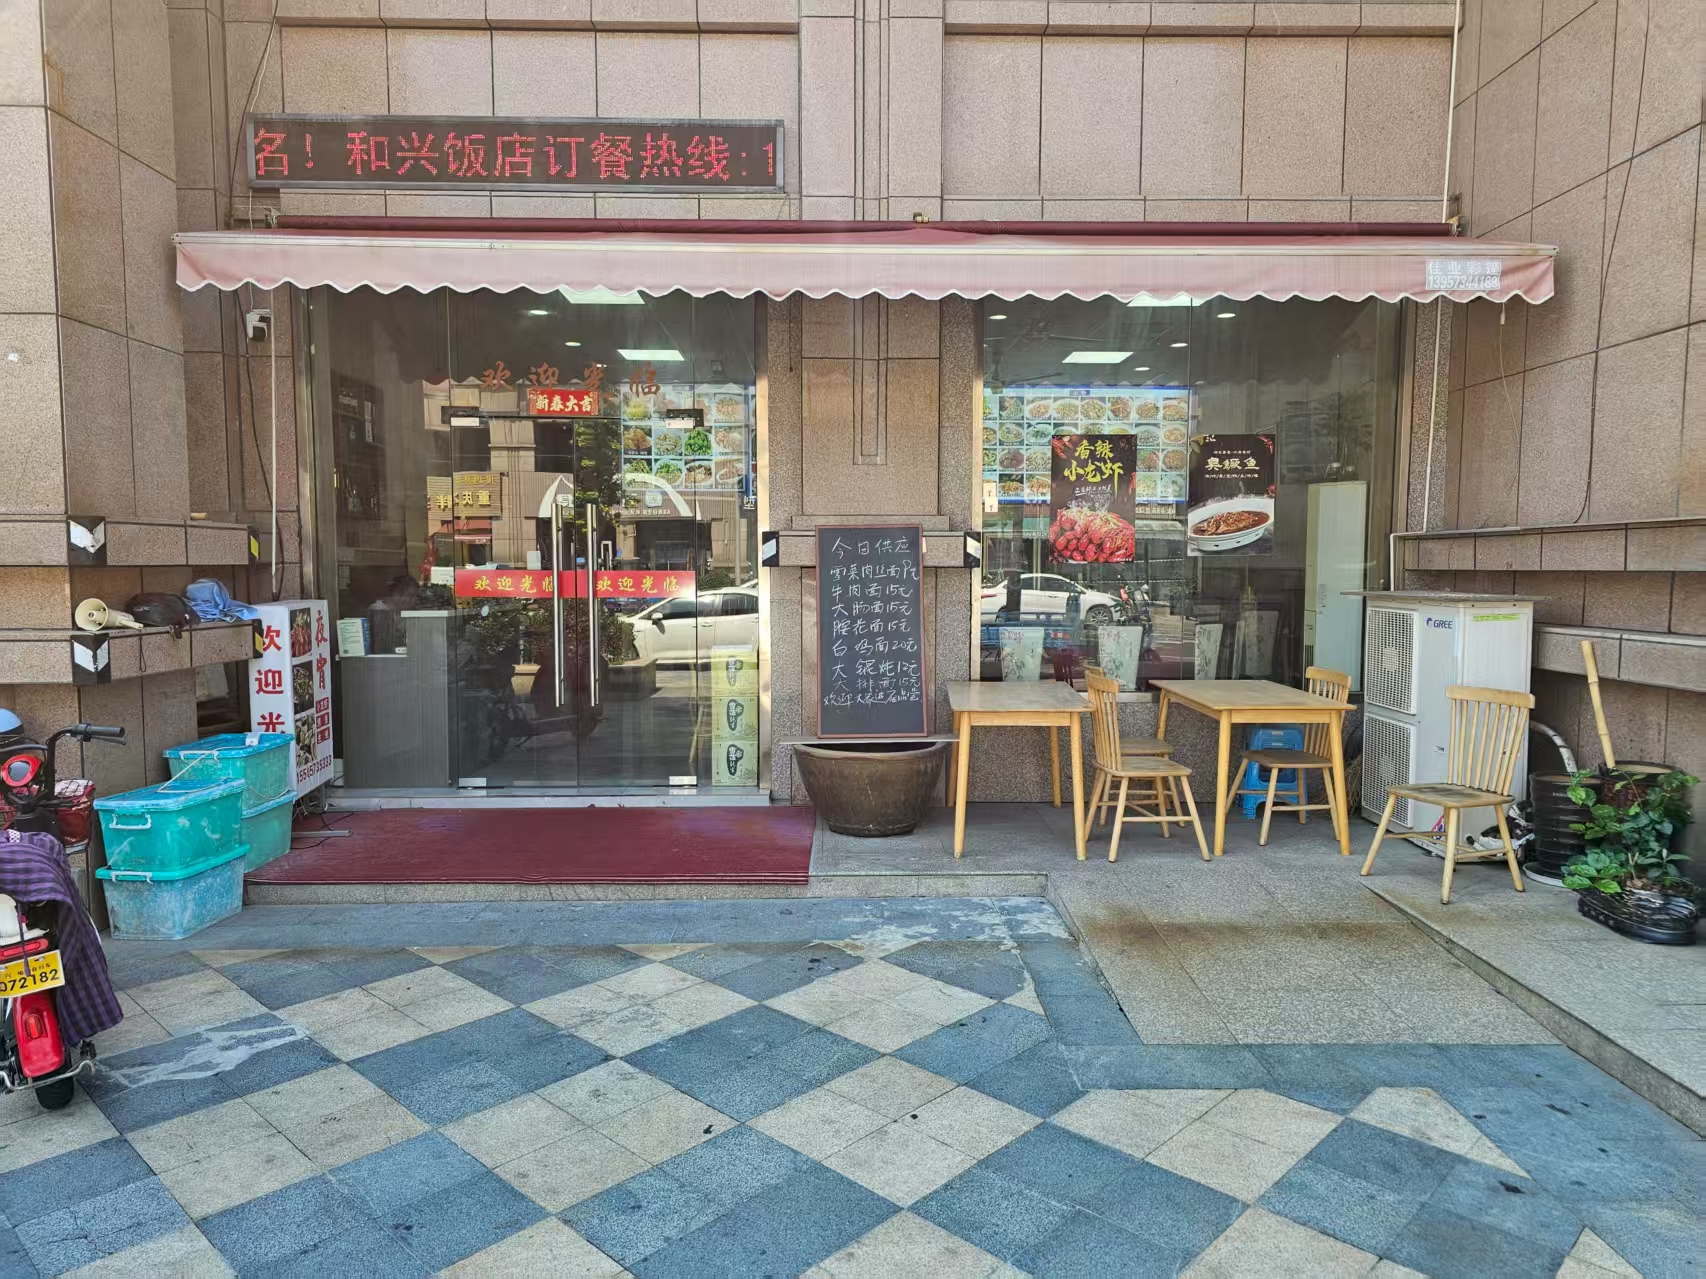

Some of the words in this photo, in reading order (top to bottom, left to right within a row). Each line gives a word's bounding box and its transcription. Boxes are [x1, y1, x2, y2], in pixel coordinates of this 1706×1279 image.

[536, 394, 593, 413] 新春大吉
[1075, 439, 1114, 460] 香辣
[1063, 459, 1124, 500] 小龙虾
[832, 536, 911, 559] 今日供应
[474, 575, 553, 593] 欢迎光临
[596, 575, 680, 593] 欢迎光临
[832, 583, 913, 603] 牛肉面15元
[832, 601, 912, 617] 大肠面15元
[1433, 619, 1453, 630] GREE
